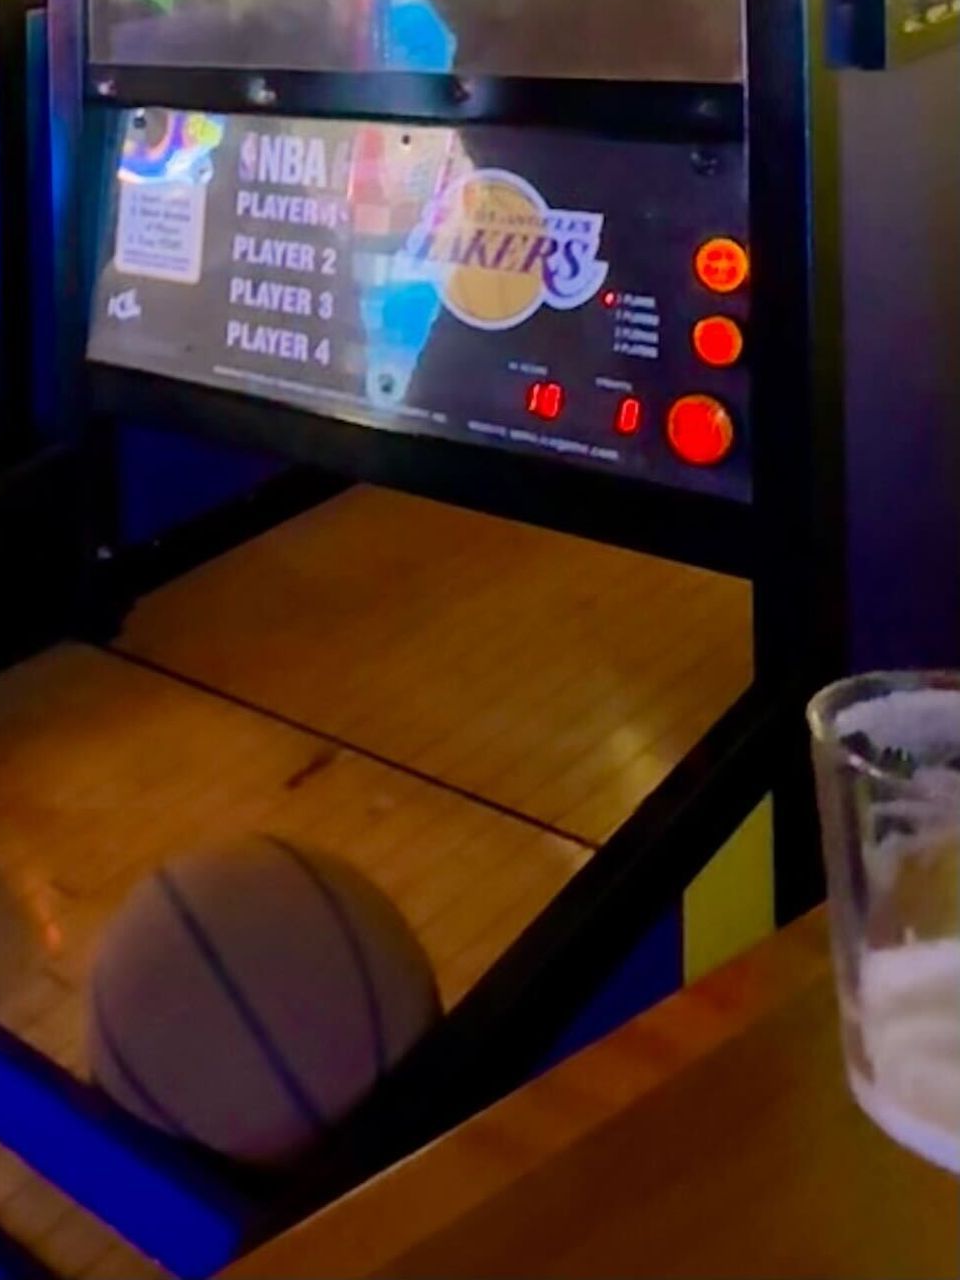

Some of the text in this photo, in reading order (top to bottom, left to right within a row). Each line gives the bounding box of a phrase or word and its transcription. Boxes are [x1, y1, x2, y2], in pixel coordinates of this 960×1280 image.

[259, 133, 327, 189] NBA
[236, 190, 319, 226] PLAYER
[232, 234, 337, 275] PLAYER 2
[229, 276, 334, 320] PLAYER 3
[226, 319, 331, 366] PLAYER 4
